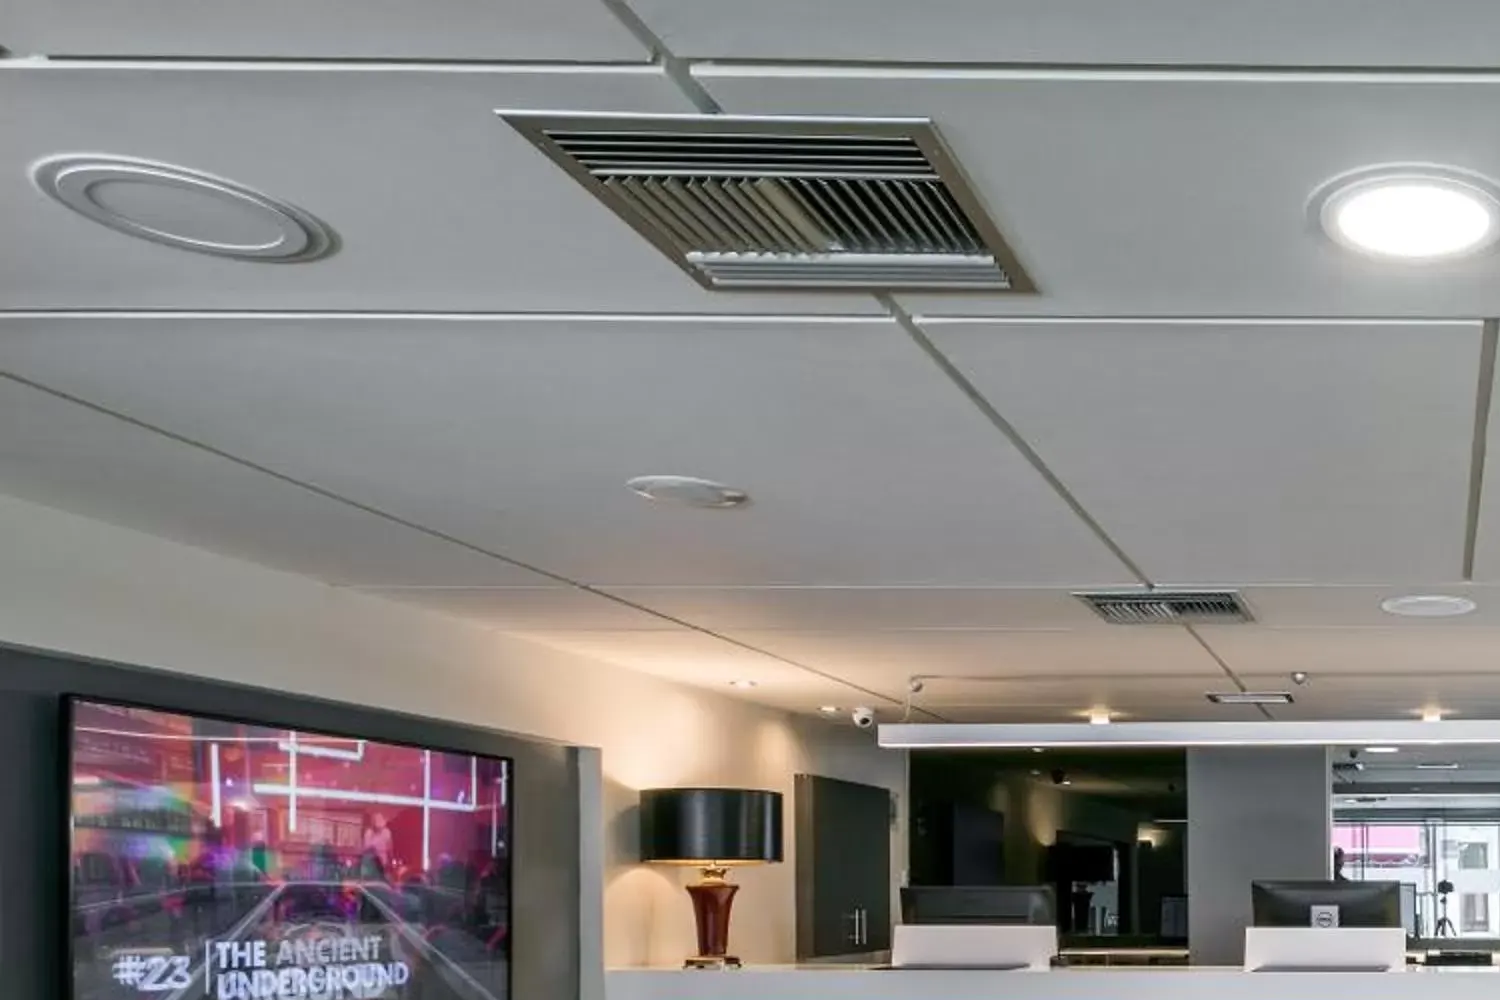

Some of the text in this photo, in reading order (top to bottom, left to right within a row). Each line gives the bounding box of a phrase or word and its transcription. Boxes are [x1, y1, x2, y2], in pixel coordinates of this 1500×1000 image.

[215, 936, 384, 968] THE ANCIENT
[112, 955, 192, 992] #23
